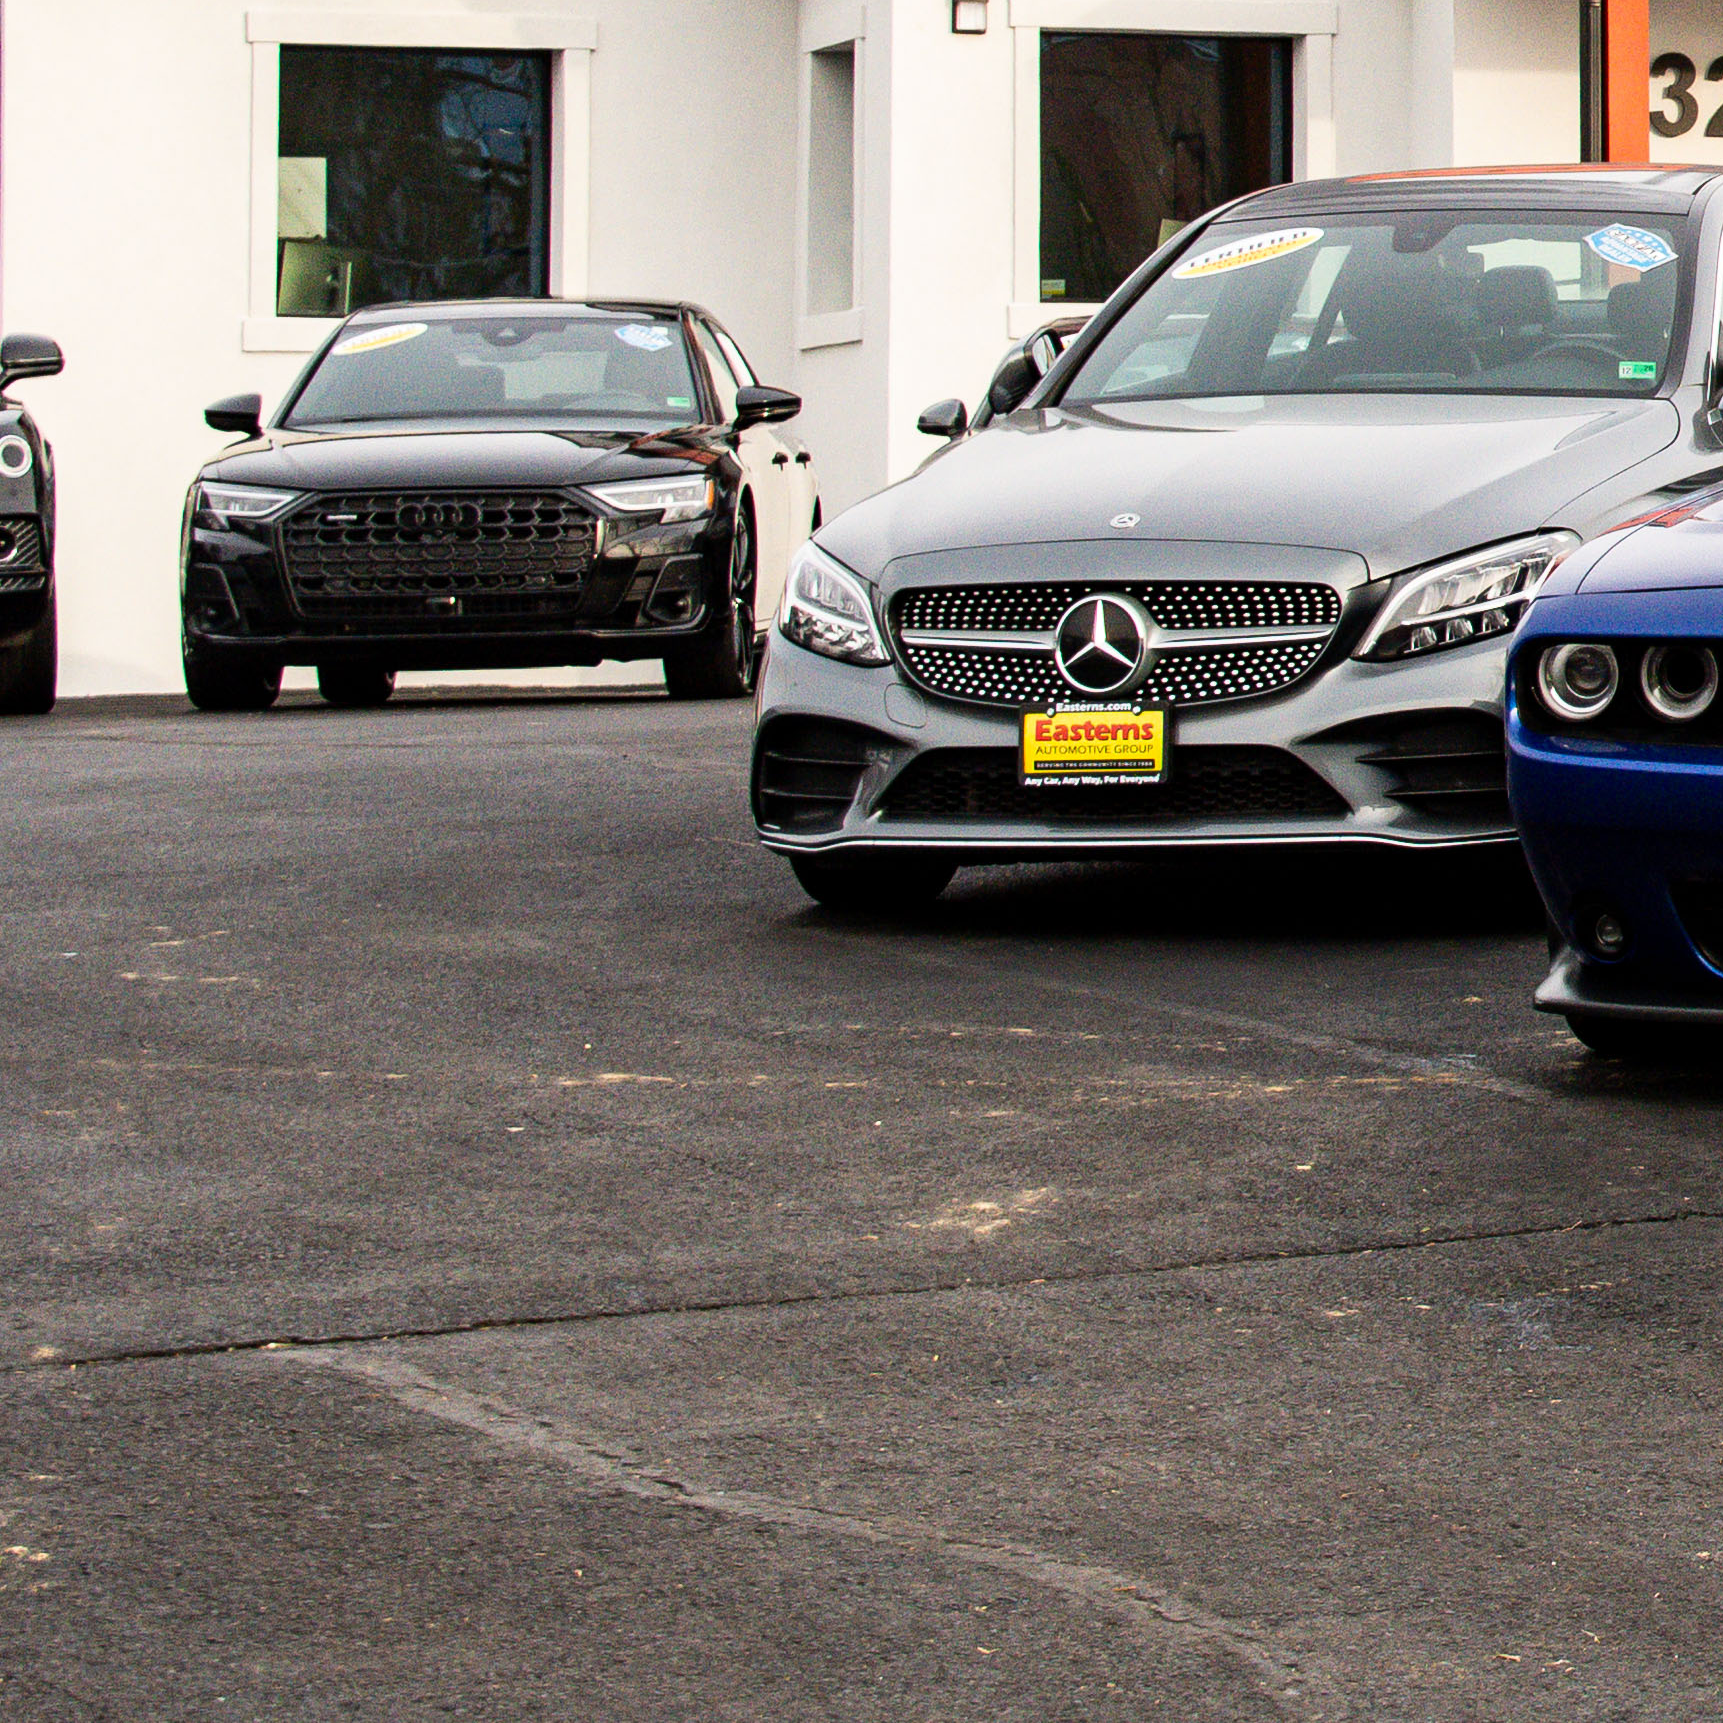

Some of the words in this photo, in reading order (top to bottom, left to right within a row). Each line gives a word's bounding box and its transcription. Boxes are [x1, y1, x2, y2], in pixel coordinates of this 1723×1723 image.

[1055, 702, 1132, 712] Easterns.com
[1035, 719, 1154, 742] Easterns
[1035, 744, 1111, 755] AUTOMOTIVE
[1113, 744, 1154, 754] GROUP
[1024, 777, 1043, 786] Any
[1043, 777, 1062, 786] Car,
[1062, 777, 1081, 786] Any
[1081, 776, 1103, 786] Way,
[1104, 775, 1119, 783] For
